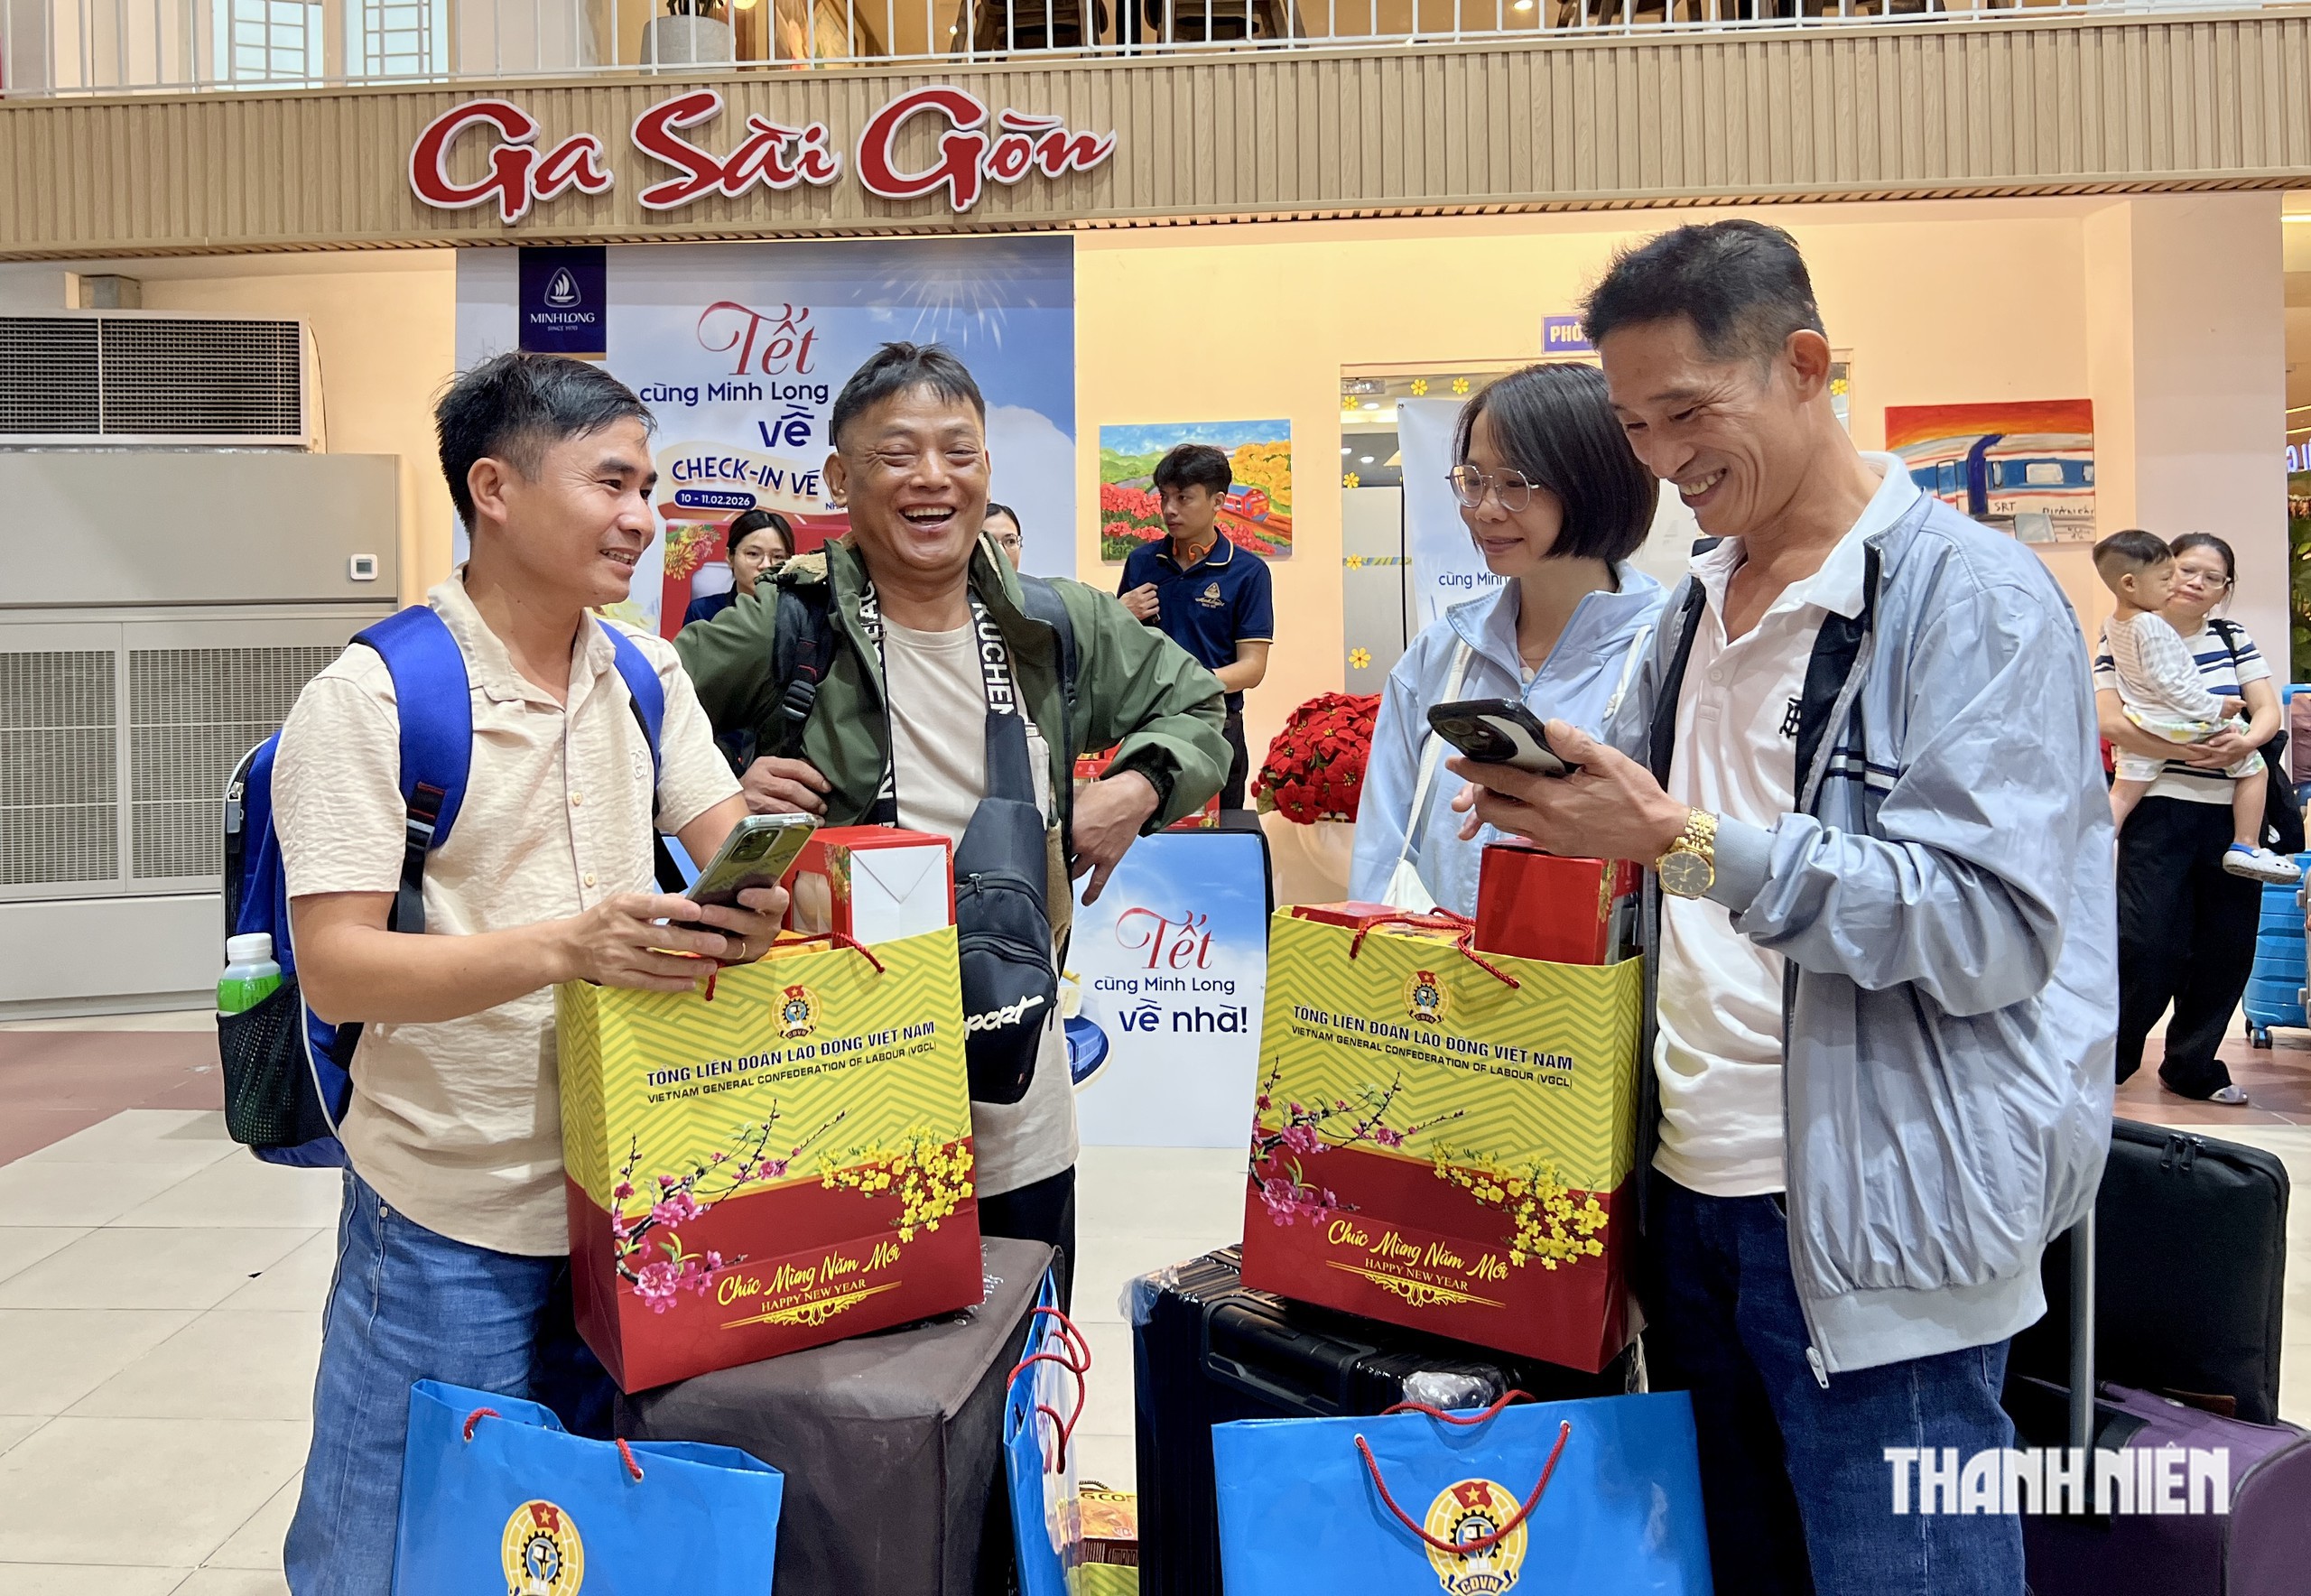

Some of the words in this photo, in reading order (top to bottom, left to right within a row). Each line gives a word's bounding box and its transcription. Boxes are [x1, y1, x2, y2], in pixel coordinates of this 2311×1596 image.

[409, 97, 615, 226] Ga
[631, 88, 841, 211] Sài
[857, 84, 1118, 214] Gòn
[697, 301, 820, 376] Tết
[1550, 320, 1589, 343] PHÒ
[640, 381, 699, 408] cùng
[708, 381, 763, 402] Minh
[771, 381, 829, 405] Long
[757, 403, 815, 448] về
[672, 456, 784, 491] CHECK-IN
[681, 493, 691, 503] 10
[701, 494, 751, 506] 11.02.2026
[1994, 501, 2017, 513] SRT
[1438, 571, 1473, 589] cùng
[1115, 907, 1216, 970] Tết
[1094, 975, 1138, 995] cùng
[1145, 976, 1186, 992] Minh
[1192, 976, 1235, 995] Long
[1118, 998, 1163, 1033] về
[1173, 1004, 1248, 1034] nhà!
[696, 1057, 733, 1079] LIÊN
[738, 1051, 782, 1072] ĐOÀN
[787, 1044, 816, 1062] LAO
[821, 1035, 863, 1060] ĐỘNG
[868, 1028, 898, 1049] VIỆT
[903, 1021, 935, 1038] NAM
[1291, 1025, 1334, 1043] VIETNAM
[1336, 1035, 1383, 1053] GENERAL
[1385, 1044, 1470, 1071] CONFEDERATION
[1473, 1062, 1487, 1072] OF
[1490, 1065, 1535, 1082] LABOUR
[1536, 1072, 1573, 1090] (VGCL)
[1332, 1012, 1365, 1033] LIÊN
[1369, 1019, 1409, 1043] ĐOÀN
[1414, 1030, 1441, 1048] LAO
[1446, 1035, 1489, 1058] ĐỘNG
[1494, 1044, 1528, 1066] VIỆT
[1533, 1052, 1573, 1072] NAM
[647, 1086, 700, 1104] VIETNAM
[702, 1078, 755, 1096] GENERAL
[757, 1062, 847, 1085] CONFEDERATION
[849, 1056, 863, 1068] OF
[866, 1049, 905, 1065] LABOUR
[908, 1042, 937, 1059] (VGCL)
[1328, 1219, 1369, 1247] Chúc
[1424, 1241, 1465, 1269] Năm
[718, 1275, 762, 1306] Chúc
[821, 1250, 860, 1282] Năm
[1365, 1257, 1403, 1275] HAPPY
[1406, 1268, 1433, 1282] NEW
[1434, 1276, 1469, 1292] YEAR
[761, 1294, 803, 1313] HAPPY
[804, 1286, 832, 1302] NEW
[833, 1277, 867, 1295] YEAR
